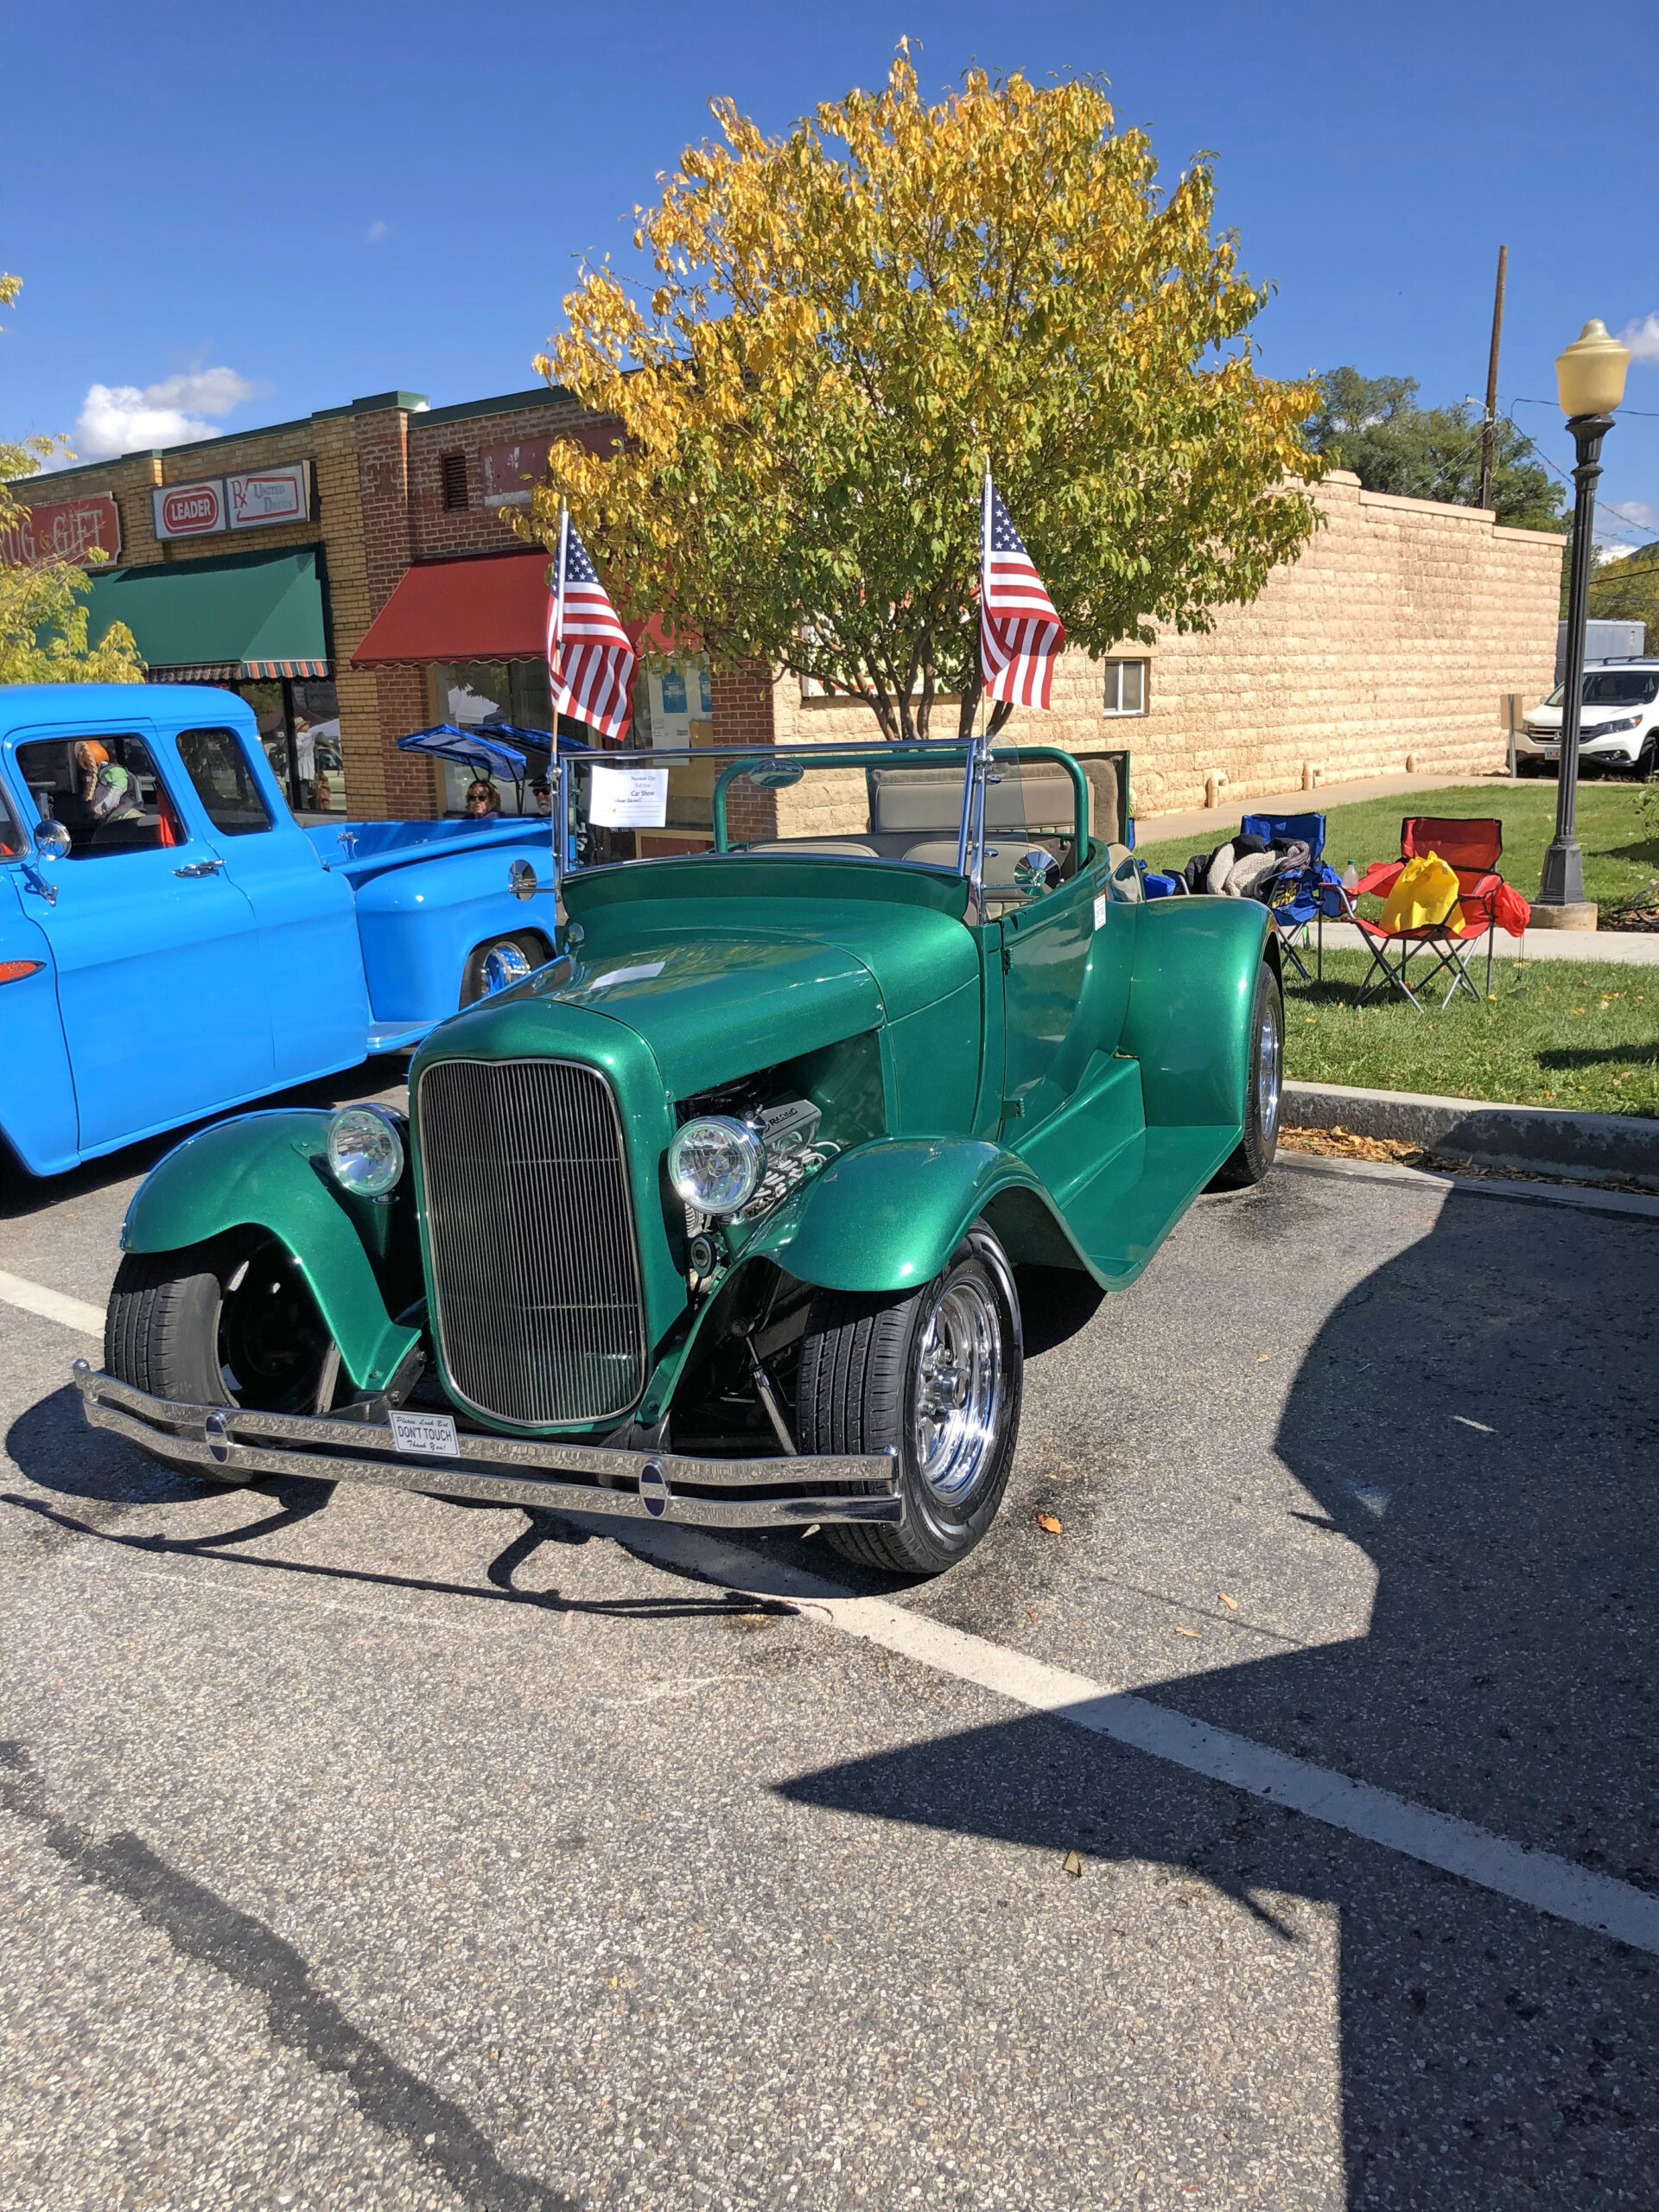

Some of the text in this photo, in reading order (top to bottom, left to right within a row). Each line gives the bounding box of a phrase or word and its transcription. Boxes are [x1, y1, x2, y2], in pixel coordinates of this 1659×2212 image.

[172, 499, 212, 522] LEADER
[54, 509, 103, 556] GIFT
[769, 1108, 798, 1126] RACING
[397, 1426, 452, 1442] DON'T TOUCH
[407, 1440, 447, 1452] Thank You!
